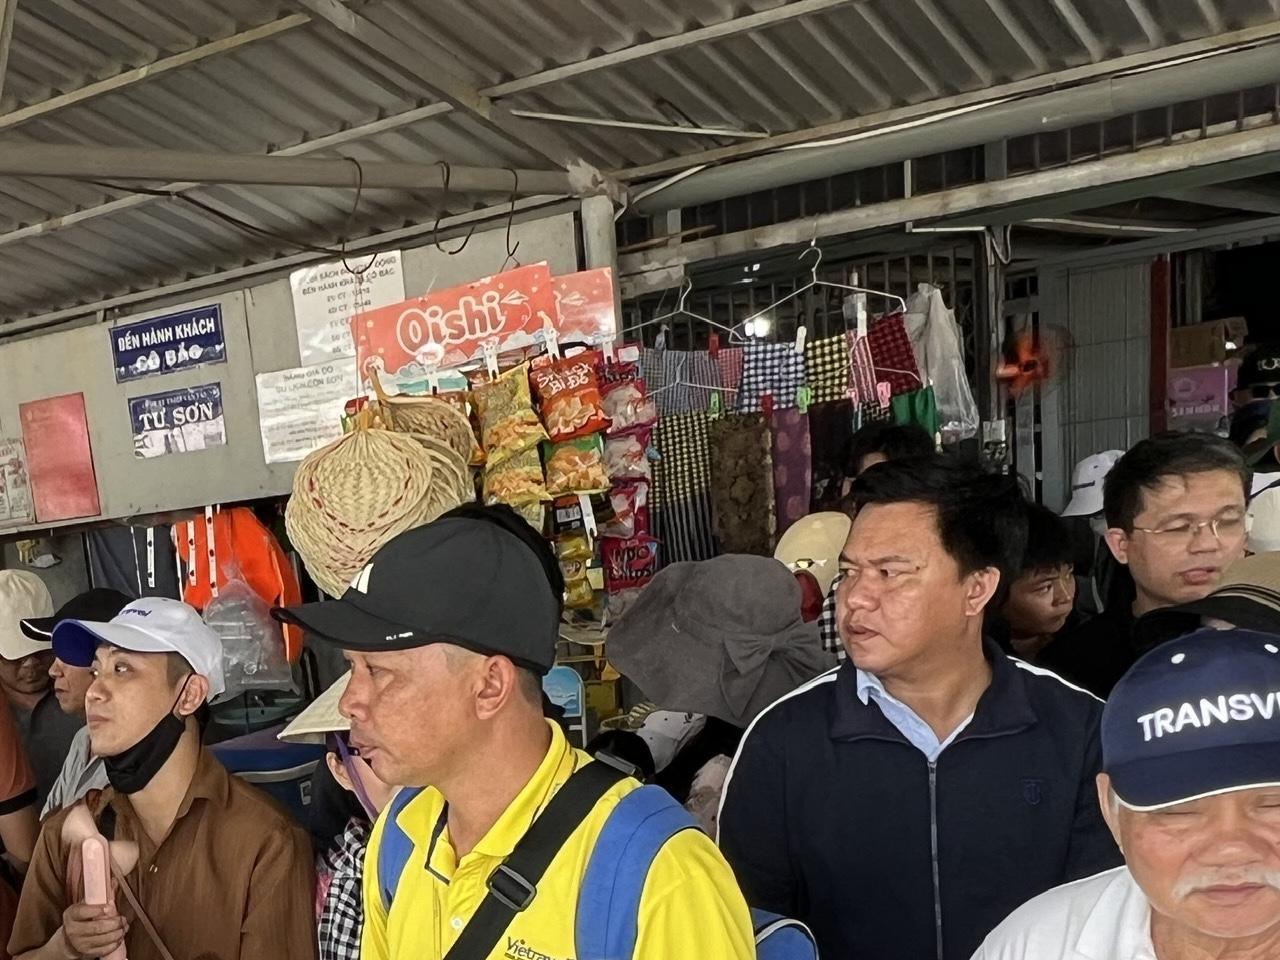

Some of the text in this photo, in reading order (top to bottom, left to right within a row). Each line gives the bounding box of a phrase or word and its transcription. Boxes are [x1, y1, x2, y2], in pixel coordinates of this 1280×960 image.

[142, 327, 173, 347] HÀNH
[175, 317, 216, 339] KHÁCH
[396, 291, 506, 356] Oishi
[173, 401, 214, 426] SƠN
